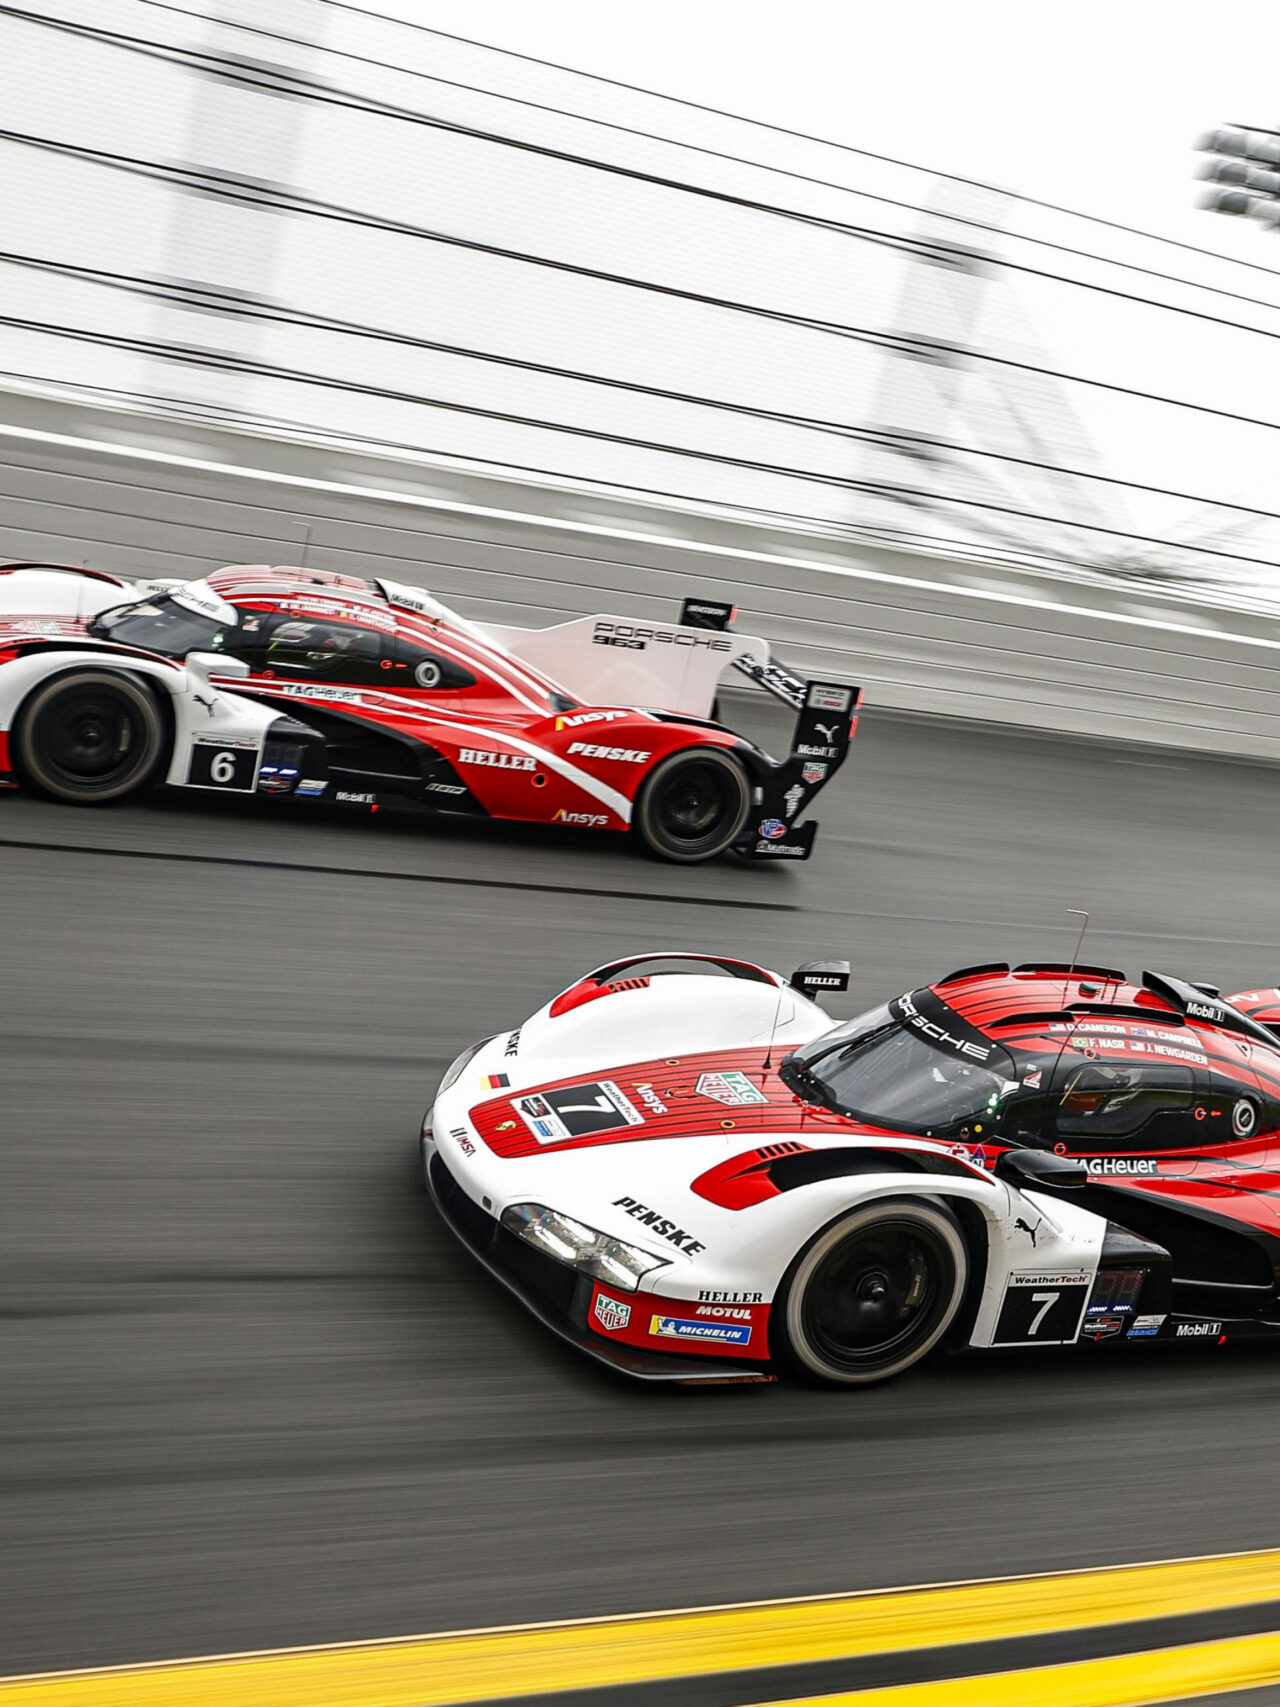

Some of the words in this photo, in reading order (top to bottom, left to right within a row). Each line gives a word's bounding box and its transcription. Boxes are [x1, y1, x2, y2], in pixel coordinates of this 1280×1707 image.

[592, 634, 647, 650] 963
[594, 622, 733, 651] PORSCHE
[555, 710, 629, 731] Ansys
[458, 748, 538, 771] HELLER
[567, 742, 652, 763] PENSKE
[210, 752, 237, 783] 6
[552, 809, 610, 827] Ansys
[804, 976, 841, 986] HELLER
[1186, 1002, 1215, 1019] Mobil
[1078, 1023, 1127, 1034] CAMERON
[1099, 1039, 1126, 1049] NASR
[1158, 1031, 1204, 1049] CAMPBELL
[1154, 1044, 1208, 1065] NEWGARDEN
[703, 1074, 742, 1104] HEUER
[724, 1073, 757, 1102] TAG
[557, 1095, 617, 1114] 7
[603, 1082, 638, 1123] WeatherTech
[632, 1082, 668, 1115] Ansys
[1073, 1158, 1157, 1174] AGHeuer
[611, 1196, 706, 1257] PENSKE
[1014, 1275, 1088, 1284] WeatherTech
[698, 1290, 763, 1303] HELLER
[600, 1297, 628, 1316] TAG
[696, 1306, 752, 1320] MOTUL
[1027, 1292, 1061, 1335] 7
[596, 1307, 627, 1329] HEUER
[678, 1325, 742, 1339] MICHELIN
[1176, 1323, 1208, 1337] Mobil
